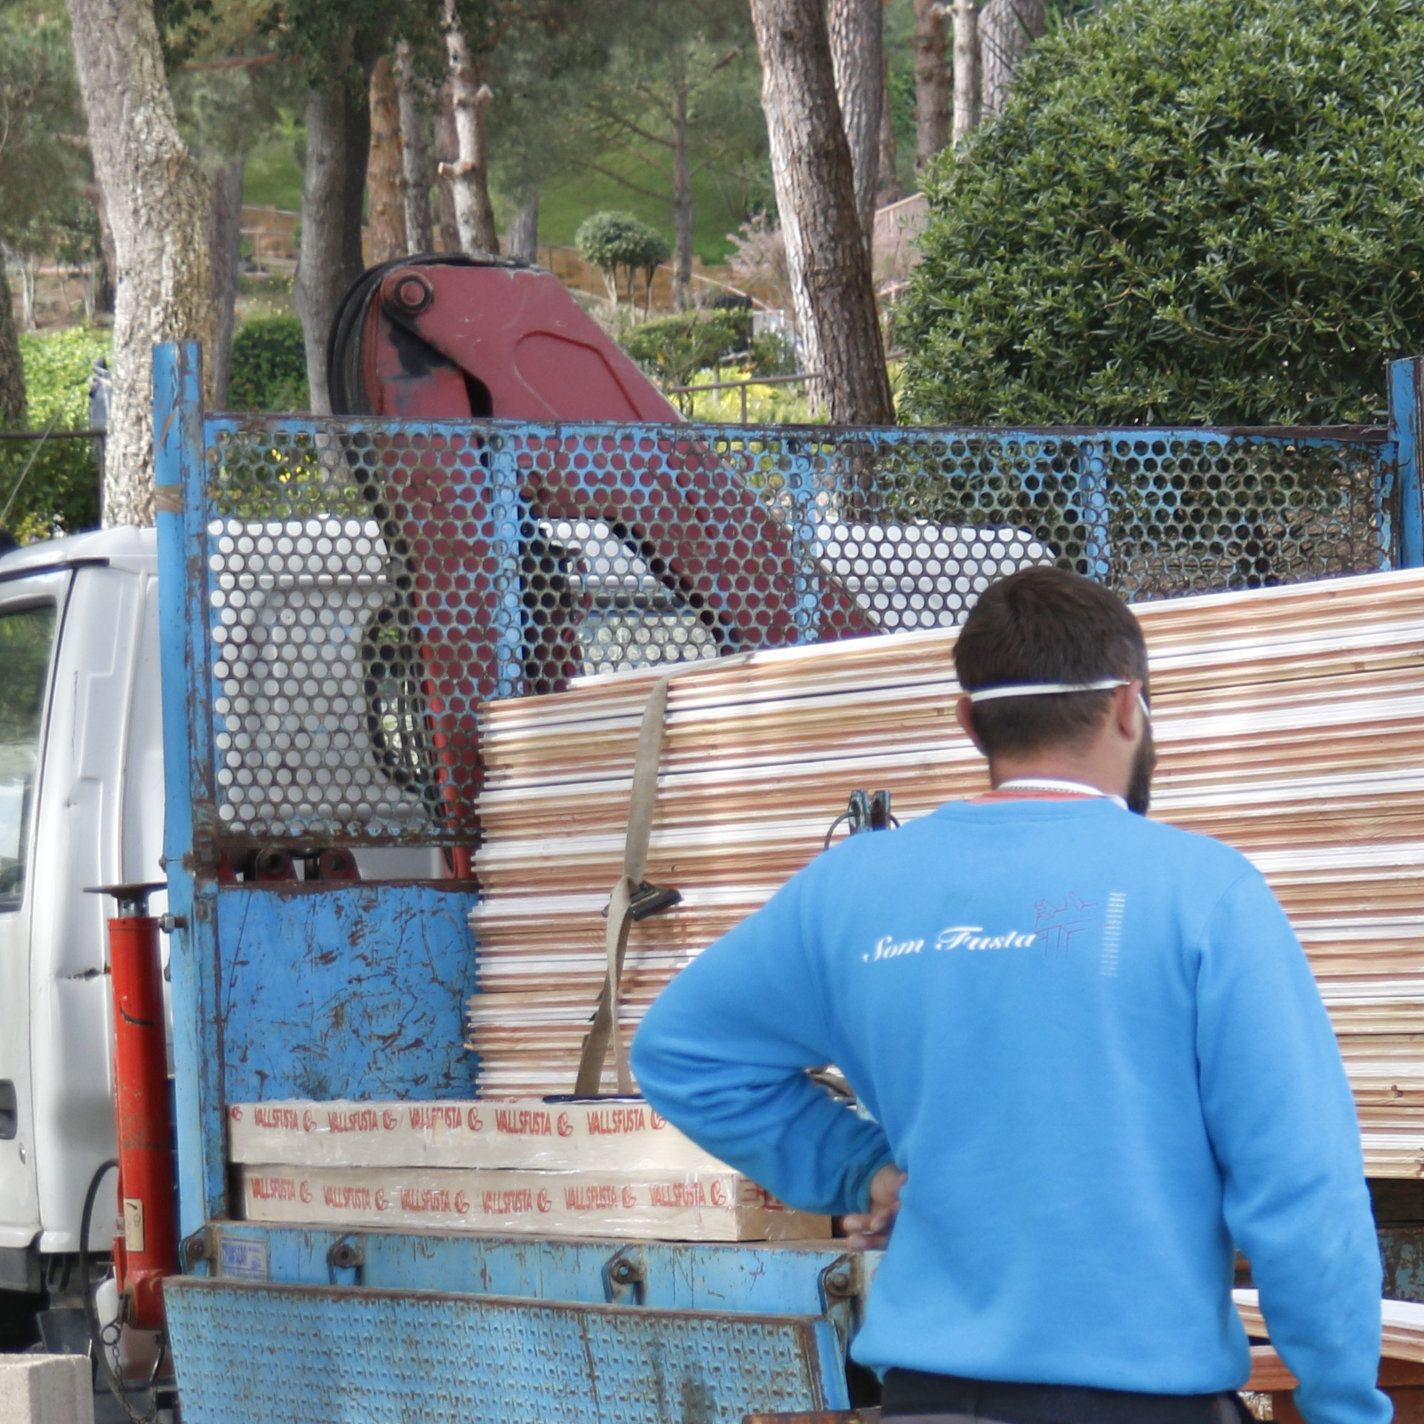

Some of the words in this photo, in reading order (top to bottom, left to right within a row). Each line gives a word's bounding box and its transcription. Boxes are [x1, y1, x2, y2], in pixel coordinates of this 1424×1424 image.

[862, 935, 925, 963] Som
[934, 925, 1037, 952] Fusta
[254, 1107, 298, 1130] VALLSFUSTA
[328, 1108, 378, 1133] VALLSFUSTA
[494, 1109, 552, 1136] VALLSFUSTA
[587, 1108, 646, 1136] VALLSFUSTA
[251, 1177, 295, 1201] VALLSFUSTA
[323, 1185, 371, 1211] VALLSFUSTA
[482, 1188, 533, 1215] VALLSFUSTA
